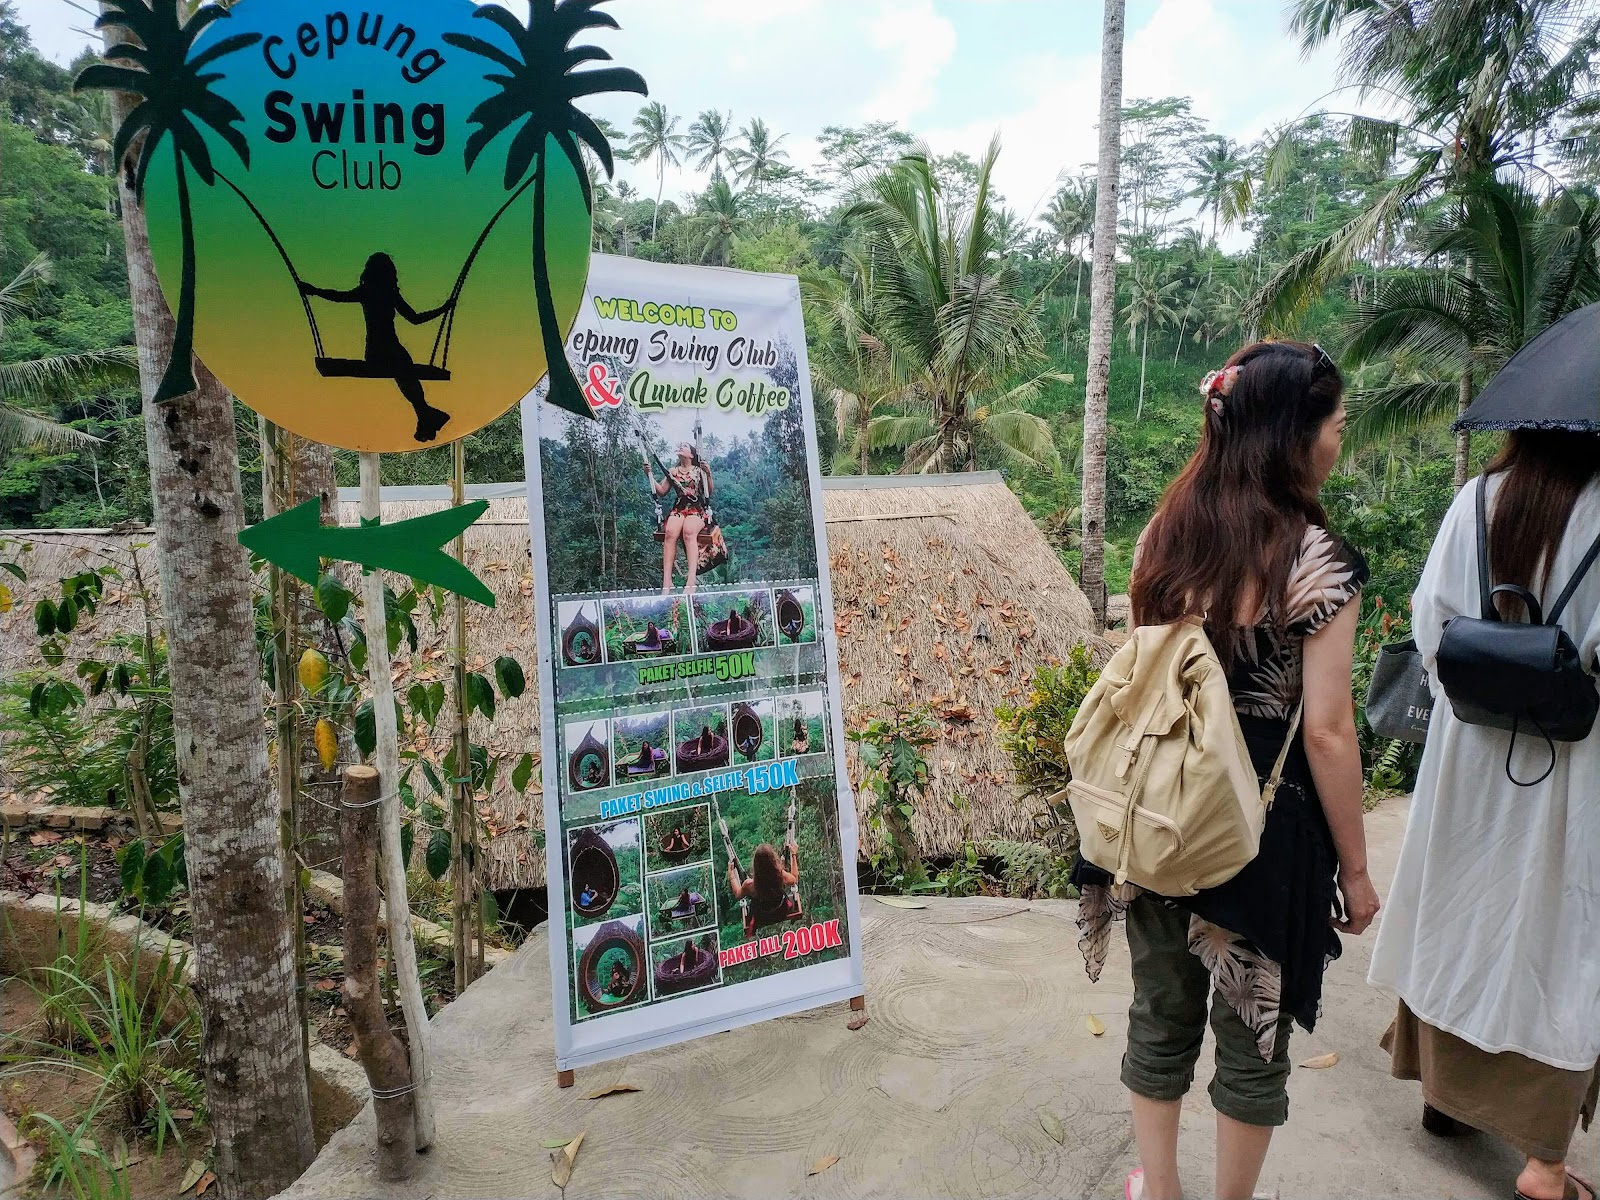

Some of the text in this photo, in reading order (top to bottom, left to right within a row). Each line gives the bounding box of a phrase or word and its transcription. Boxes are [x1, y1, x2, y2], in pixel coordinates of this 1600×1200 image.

[262, 11, 446, 84] Cepung
[264, 89, 445, 156] Swing
[312, 149, 401, 190] Club
[594, 296, 738, 331] WELCOME TO
[572, 328, 777, 371] epung Swing Club
[584, 364, 788, 414] & Luwak Coffee
[639, 651, 756, 684] PAKET SELFIE 50K
[600, 759, 800, 819] PAKET SWING & SELFIE 150K
[720, 919, 842, 968] PAKET ALL 200K
